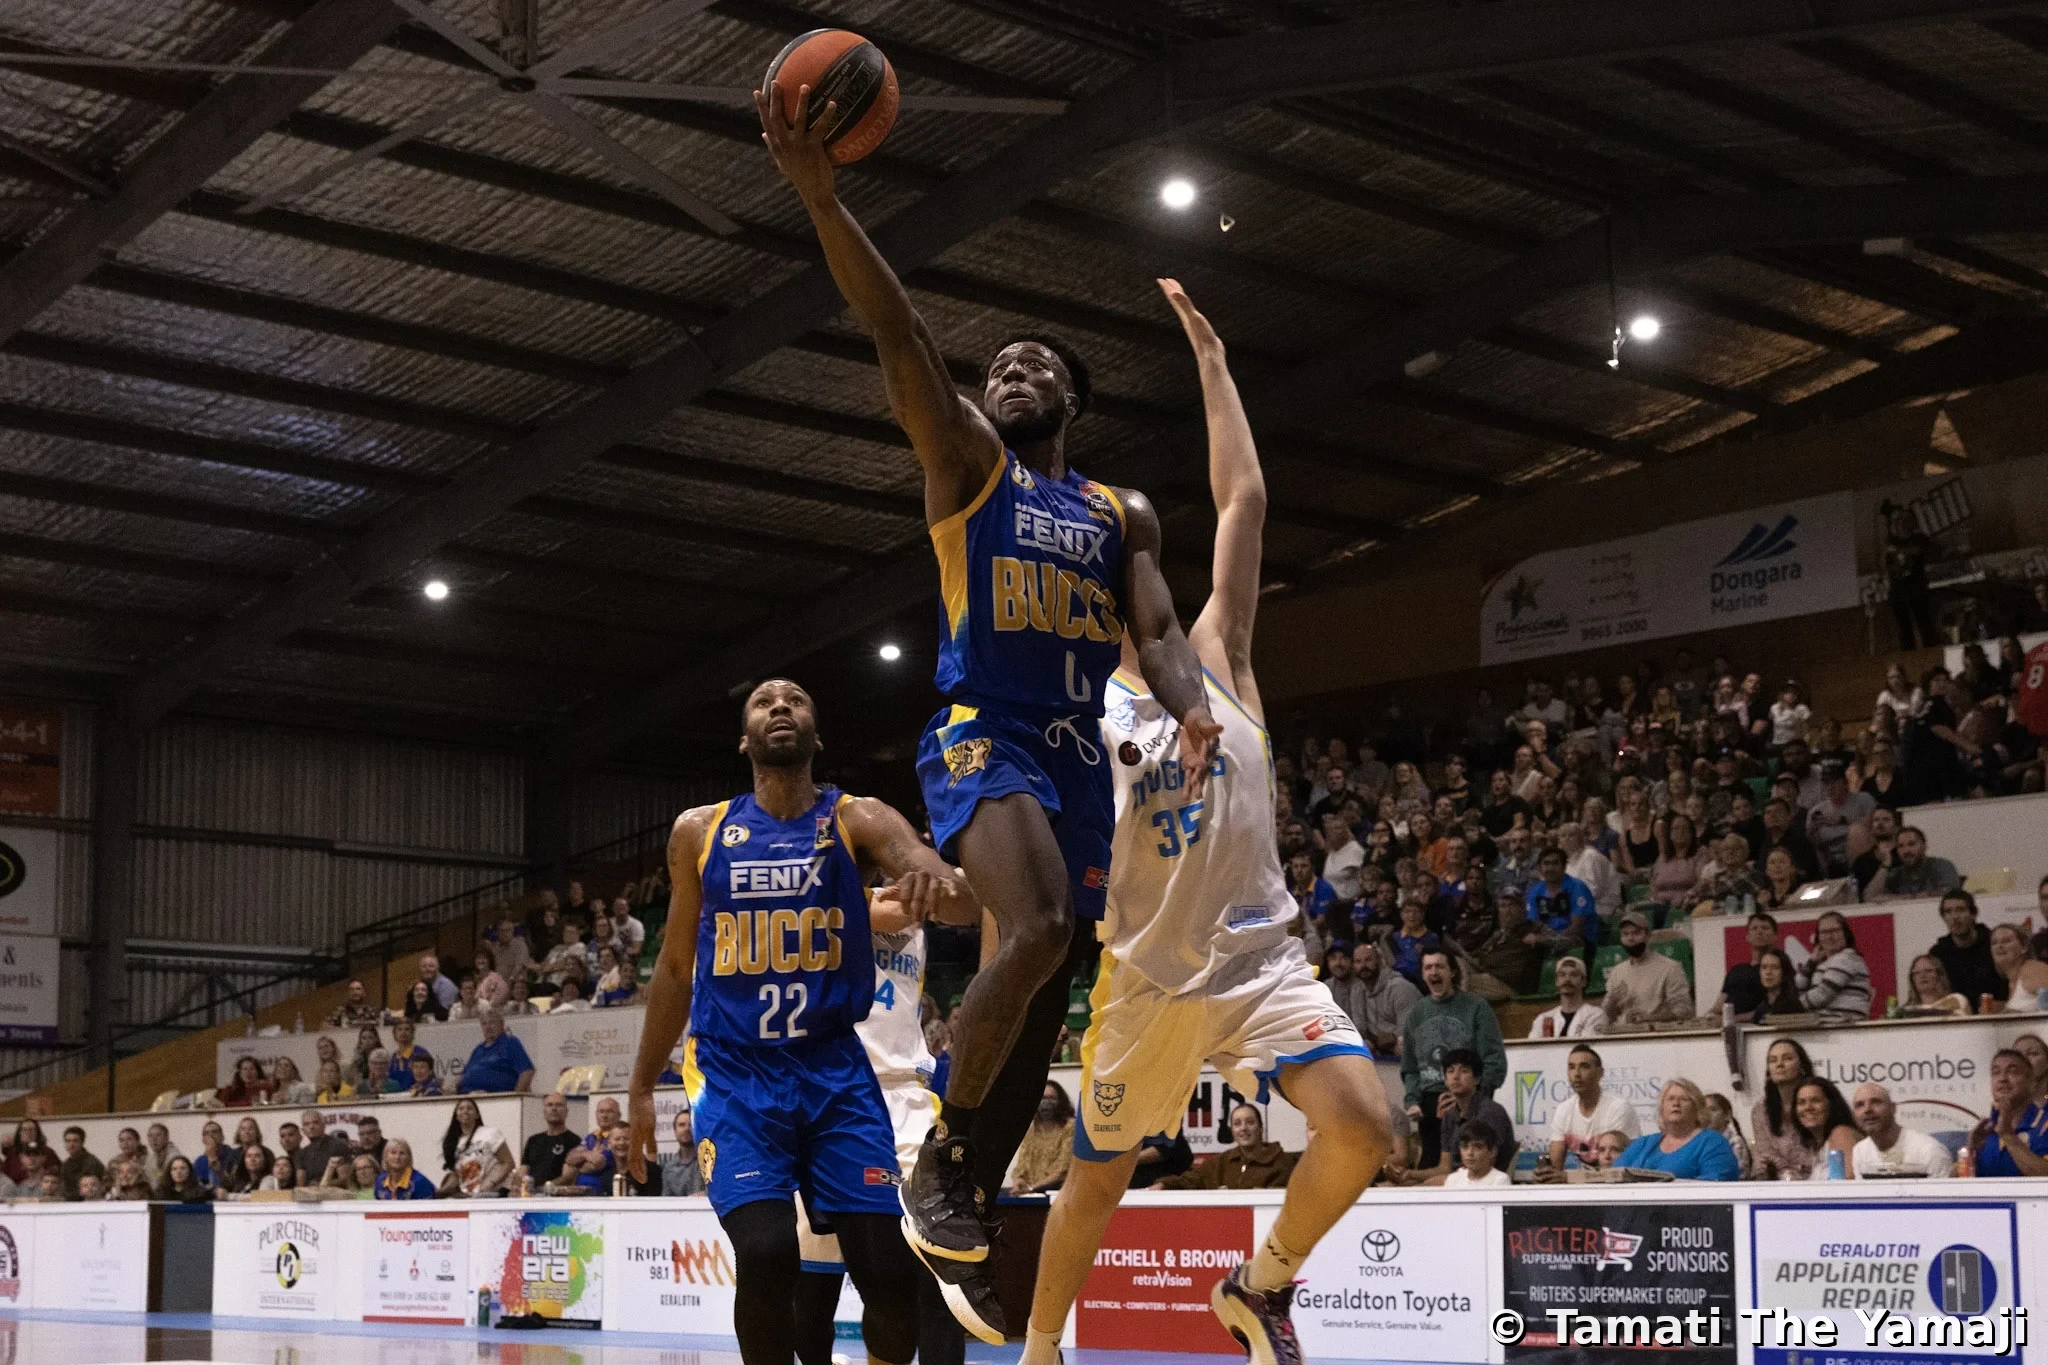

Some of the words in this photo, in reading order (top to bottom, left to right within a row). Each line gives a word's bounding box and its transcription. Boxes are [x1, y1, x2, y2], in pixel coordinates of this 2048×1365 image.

[1911, 477, 1972, 538] hill
[1015, 504, 1110, 564] FENIX
[1711, 563, 1802, 593] Dongara
[992, 556, 1122, 646] BUCCS
[1711, 593, 1768, 614] Marine
[2027, 664, 2044, 689] 8
[1152, 799, 1205, 859] 35
[730, 857, 826, 897] FENIX
[713, 907, 846, 976] BUCCS
[4, 945, 16, 965] &
[759, 982, 809, 1039] 22
[1826, 1053, 1976, 1084] Luscombe
[259, 1220, 320, 1251] PURCHER
[379, 1226, 453, 1246] Youngmotors
[523, 1235, 570, 1256] new
[1661, 1227, 1714, 1249] PROUD
[1165, 1249, 1176, 1268] &
[1180, 1250, 1245, 1268] BROWN
[1521, 1252, 1603, 1265] SUPERMARKETS
[1819, 1243, 1921, 1258] GERALDTON
[522, 1257, 569, 1282] era
[650, 1266, 669, 1280] 98.1
[1358, 1264, 1404, 1277] TOYOTA
[1646, 1252, 1730, 1273] SPONSORS
[1132, 1269, 1193, 1288] retraVision
[1295, 1288, 1397, 1310] Geraldton
[1403, 1291, 1472, 1316] Toyota
[1529, 1286, 1576, 1303] RIGTERS
[1579, 1286, 1663, 1304] SUPERMARKET
[1666, 1289, 1707, 1305] GROUP
[1321, 1319, 1352, 1331] Genuine
[1354, 1319, 1384, 1333] Service,
[1386, 1321, 1418, 1332] Genuine
[1420, 1322, 1446, 1333] Value.
